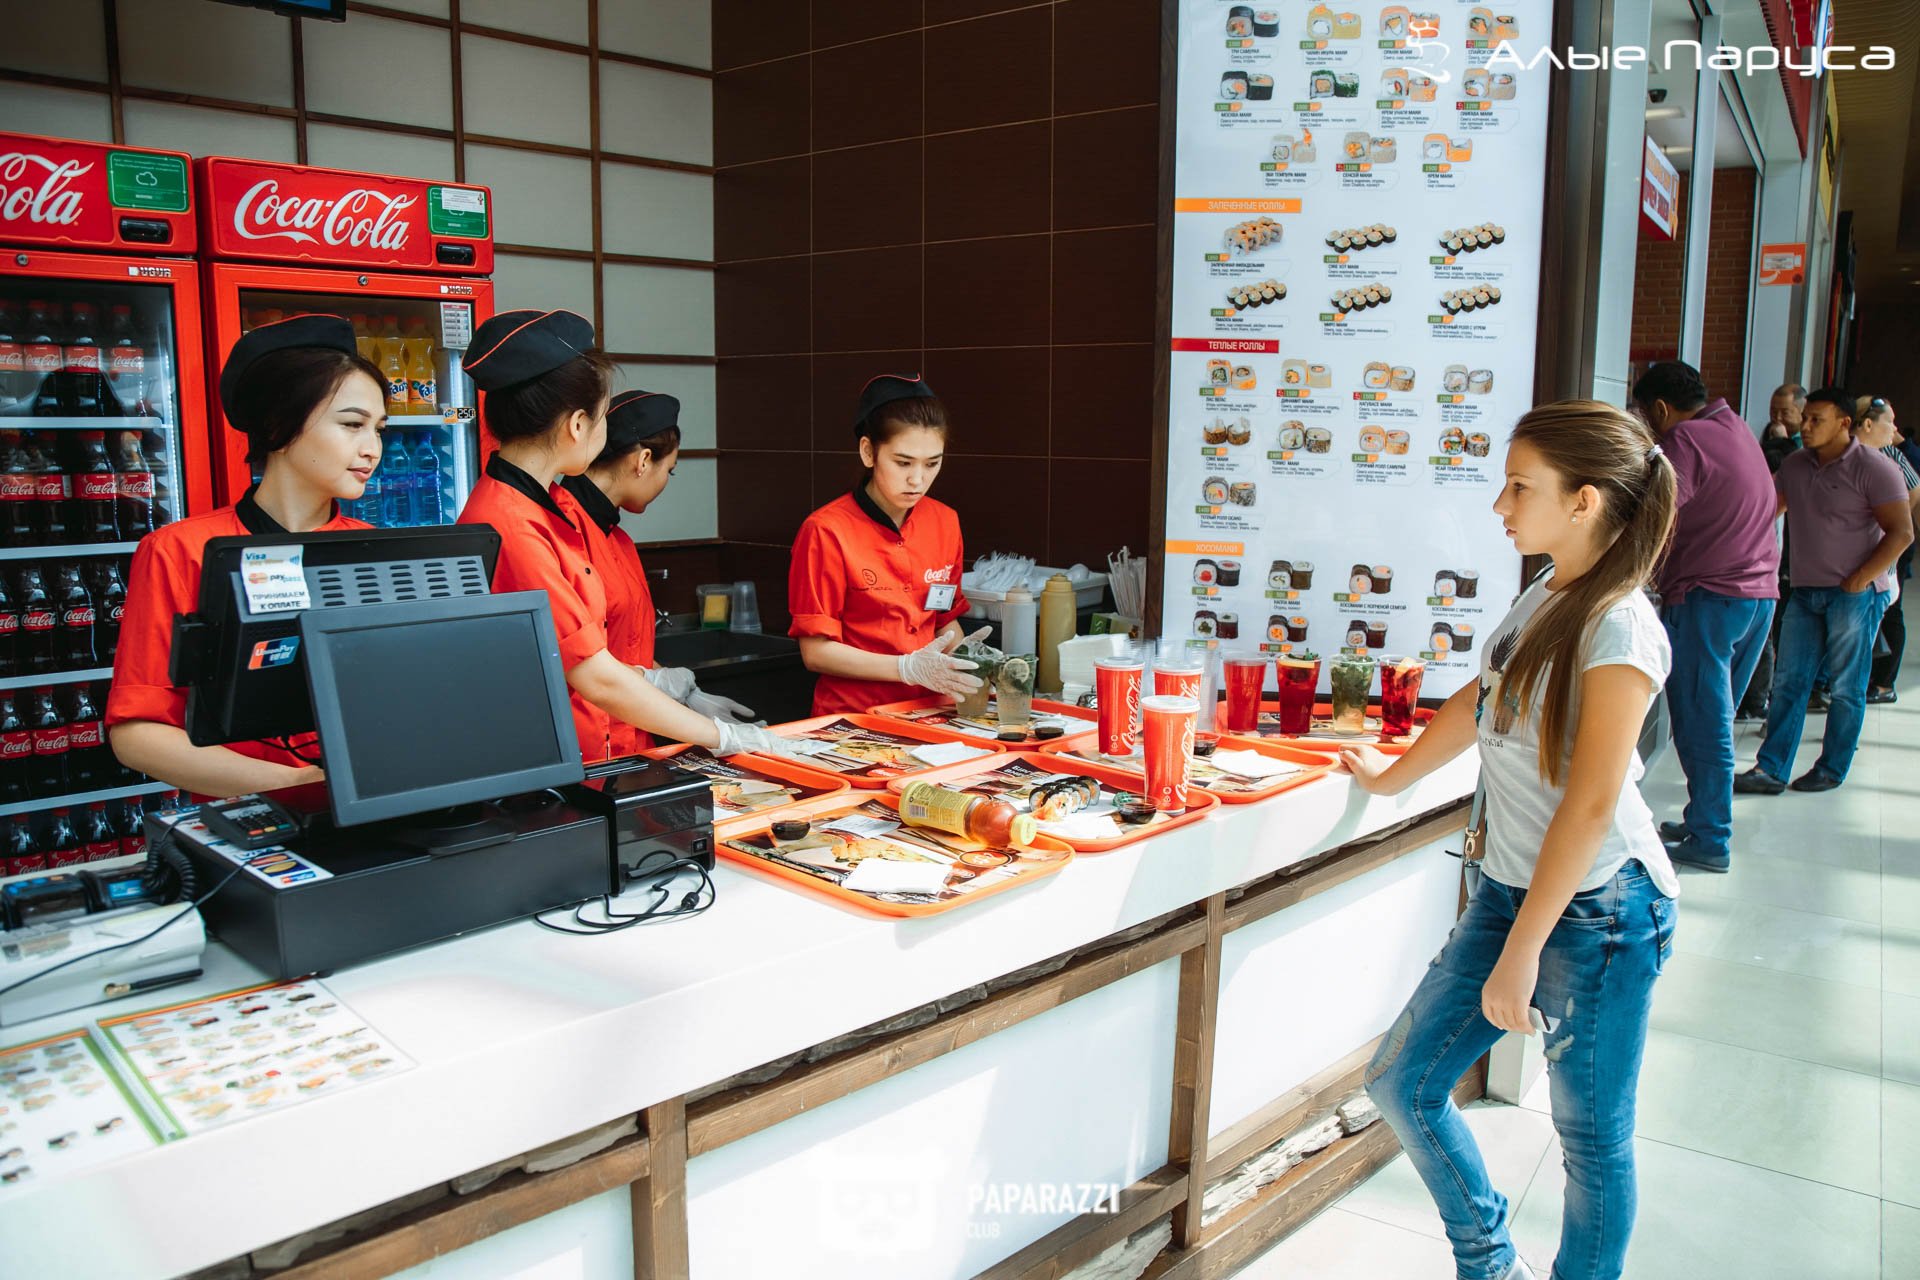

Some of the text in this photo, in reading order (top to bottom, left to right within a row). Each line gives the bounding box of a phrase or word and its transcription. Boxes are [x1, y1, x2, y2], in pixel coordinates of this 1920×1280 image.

[234, 180, 418, 250] Coca-Cola
[1208, 340, 1266, 351] ТЕПЛЫЕ РОЛЛЫ
[245, 553, 267, 561] Visa
[253, 591, 306, 600] ПРИНИМАЕМ
[267, 601, 302, 610] ОПЛАТЕ
